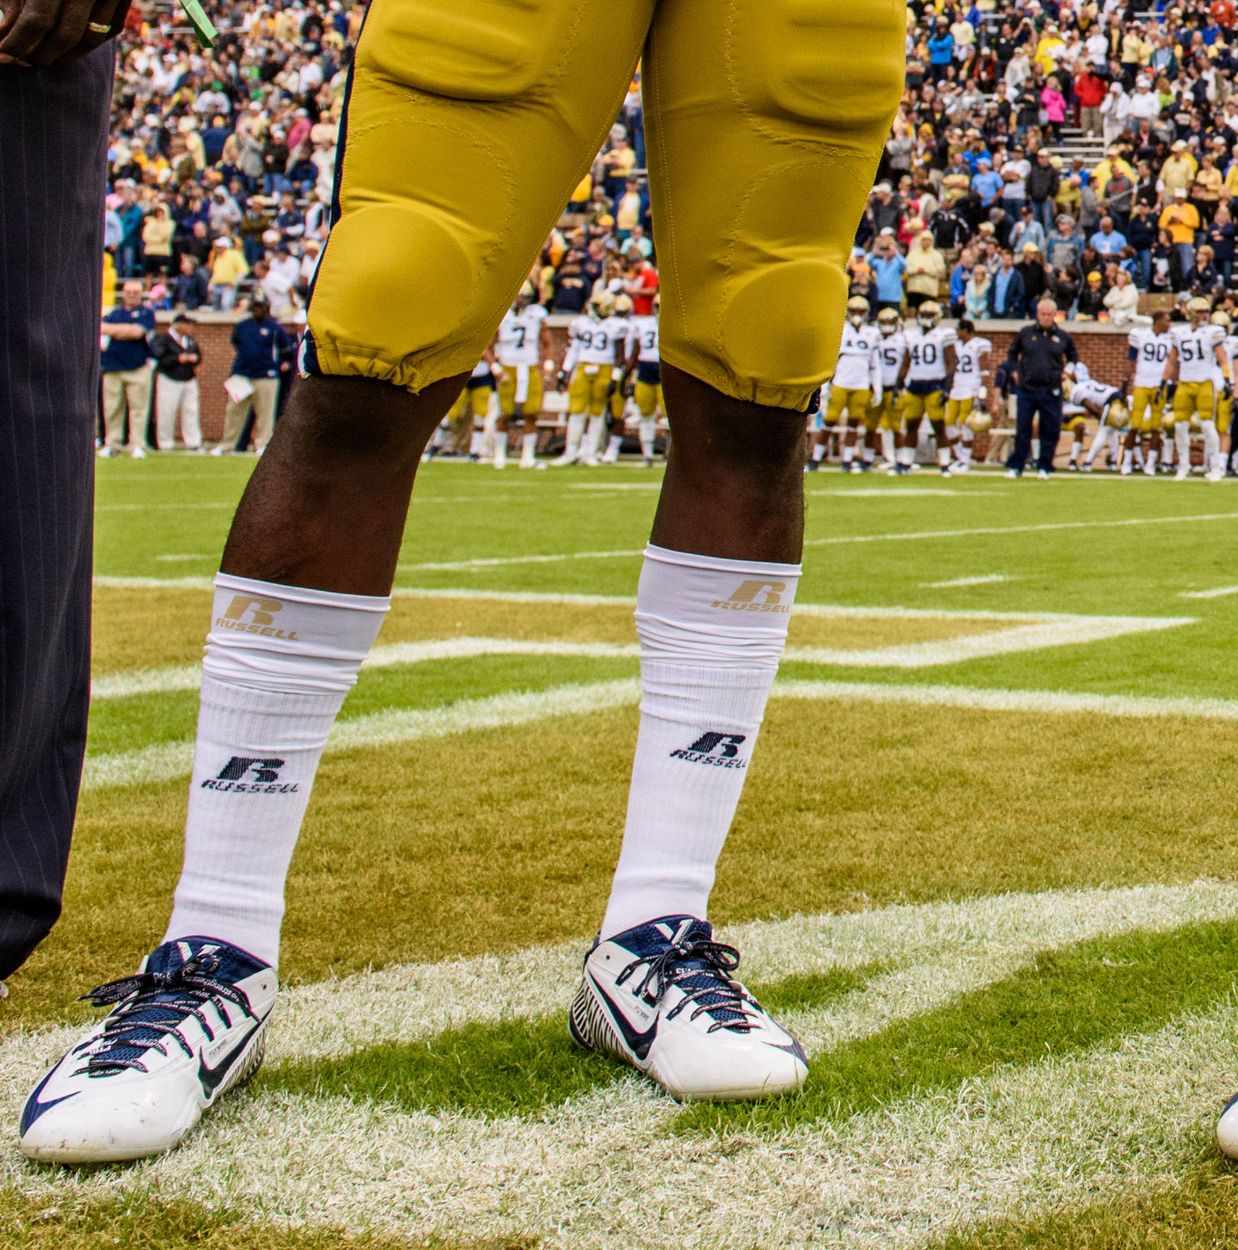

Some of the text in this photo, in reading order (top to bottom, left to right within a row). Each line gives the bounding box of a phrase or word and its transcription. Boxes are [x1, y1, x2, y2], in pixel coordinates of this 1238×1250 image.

[910, 344, 936, 366] 40
[1143, 342, 1168, 362] 90
[1181, 339, 1205, 361] 51
[710, 600, 791, 613] RUSSELL
[215, 617, 299, 641] RUSSELL
[670, 749, 748, 769] RUSSELL
[201, 779, 300, 794] RUSSELL
